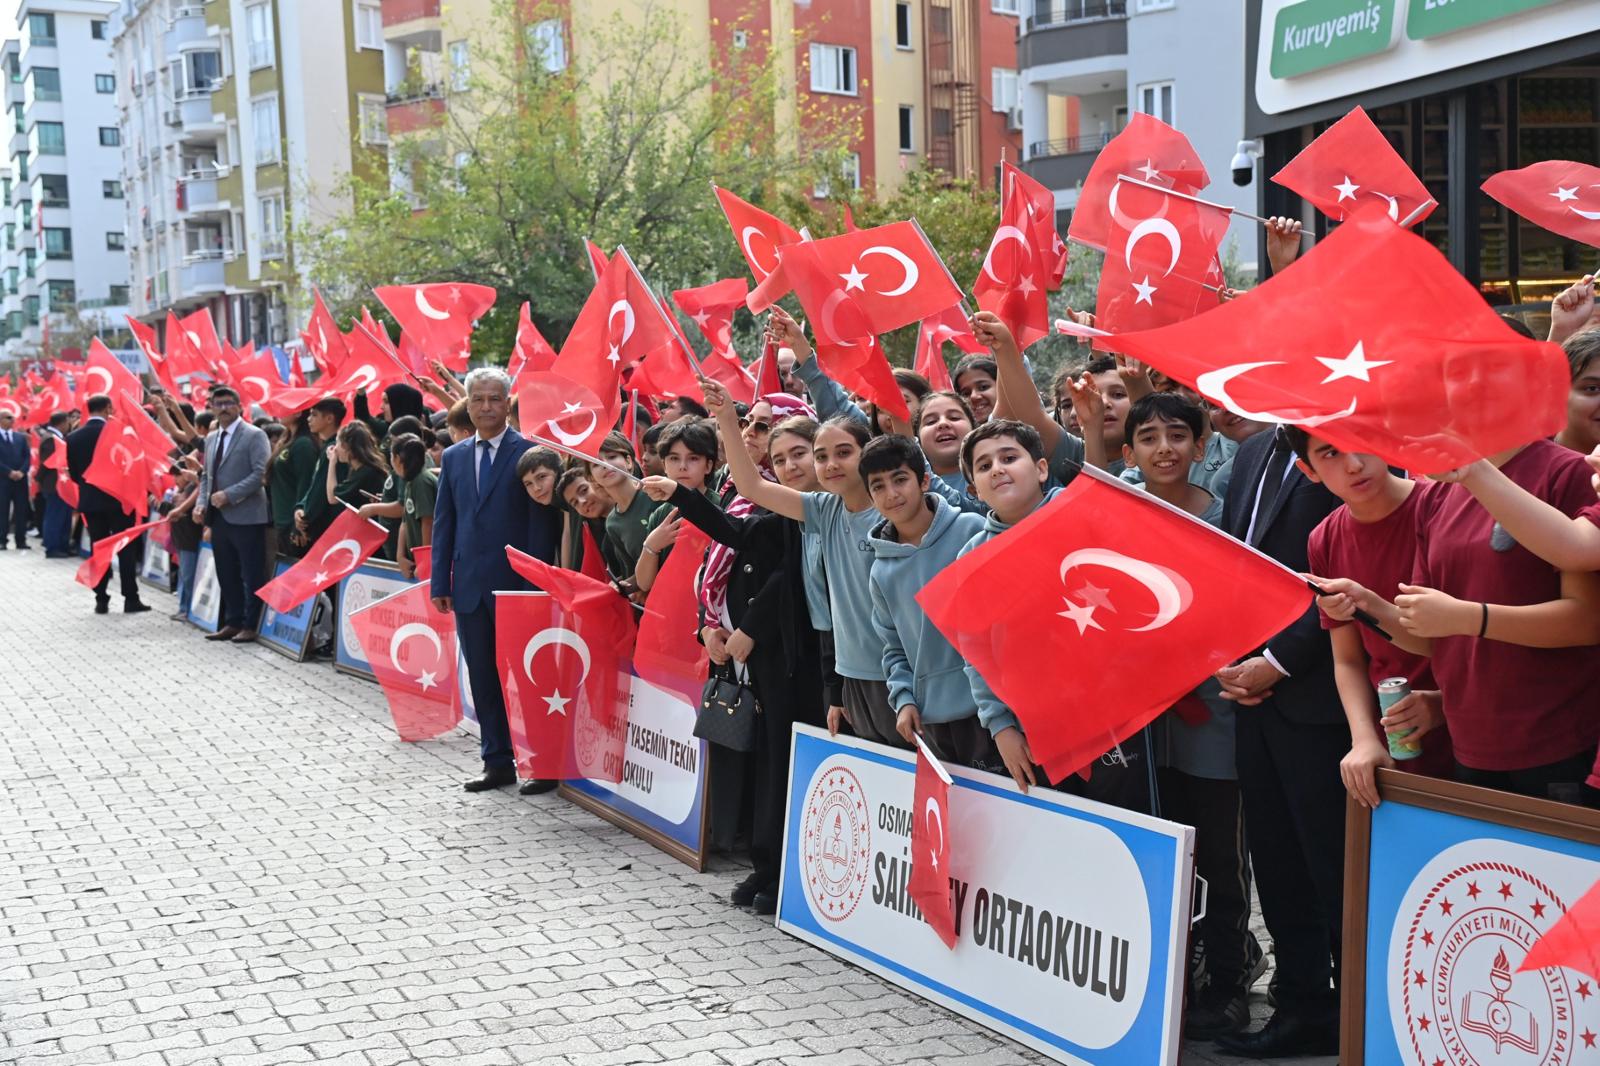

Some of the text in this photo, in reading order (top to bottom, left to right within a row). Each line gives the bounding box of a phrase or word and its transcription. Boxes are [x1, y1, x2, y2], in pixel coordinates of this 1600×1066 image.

[1283, 0, 1381, 53] Kuruyemiş
[603, 751, 654, 794] ORTOKULU
[631, 722, 669, 761] YASEMİN
[669, 739, 697, 774] TEKİN
[878, 802, 913, 839] OSMA
[872, 846, 1129, 1003] SAİY ORTAOKULU
[1437, 913, 1494, 1005] CUMHURİYETİ
[1545, 965, 1568, 1021] ĞİTİM
[1441, 1013, 1472, 1066] RKİYE
[1549, 1028, 1568, 1066] BAK
